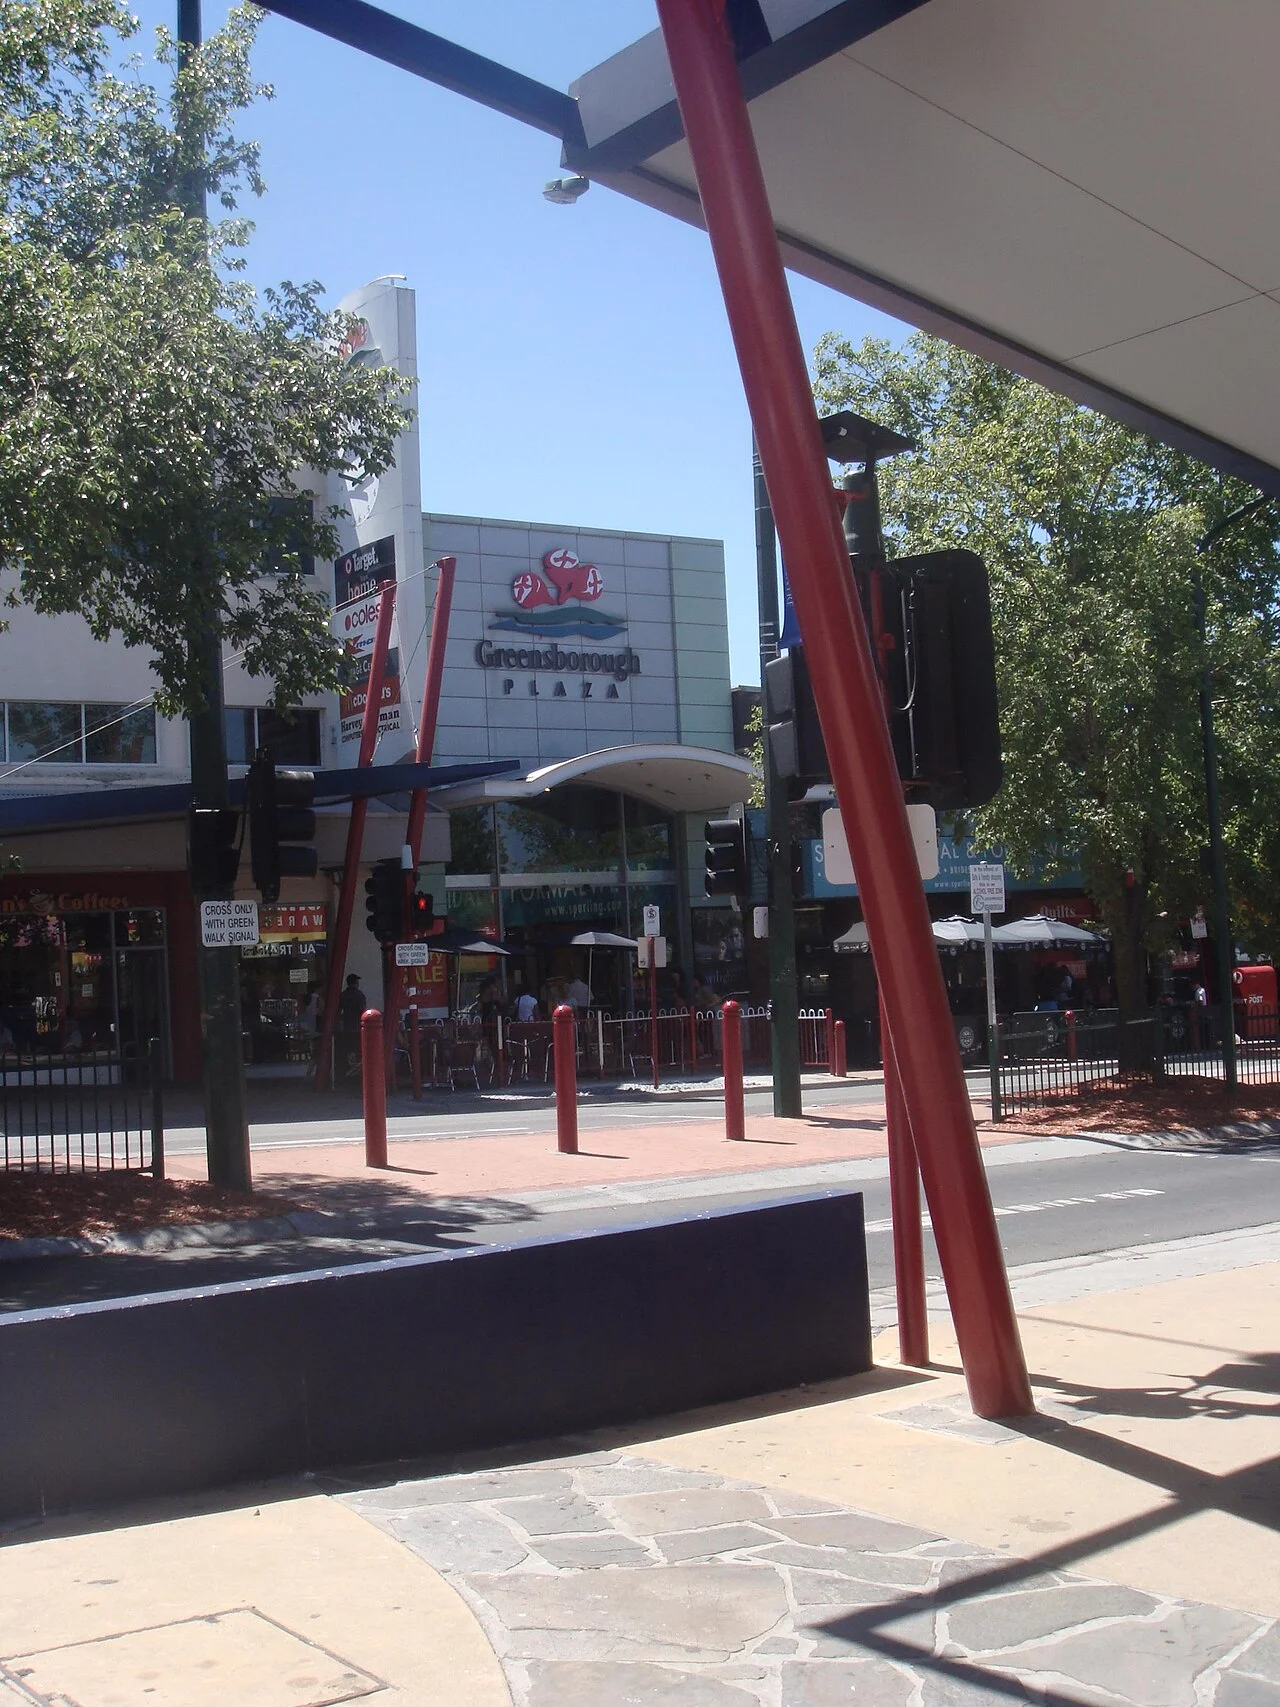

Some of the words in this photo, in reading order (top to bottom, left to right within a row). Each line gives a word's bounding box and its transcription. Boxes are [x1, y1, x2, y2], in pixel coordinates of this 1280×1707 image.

[475, 639, 642, 682] Greensborough
[503, 678, 620, 699] PLAZA
[205, 904, 232, 916] CROSS
[234, 904, 254, 915] ONLY
[206, 918, 226, 929] WITH
[228, 917, 254, 928] GREEN
[204, 932, 226, 943] WALK
[228, 931, 256, 942] SIGNAL
[1248, 995, 1264, 1005] POST
